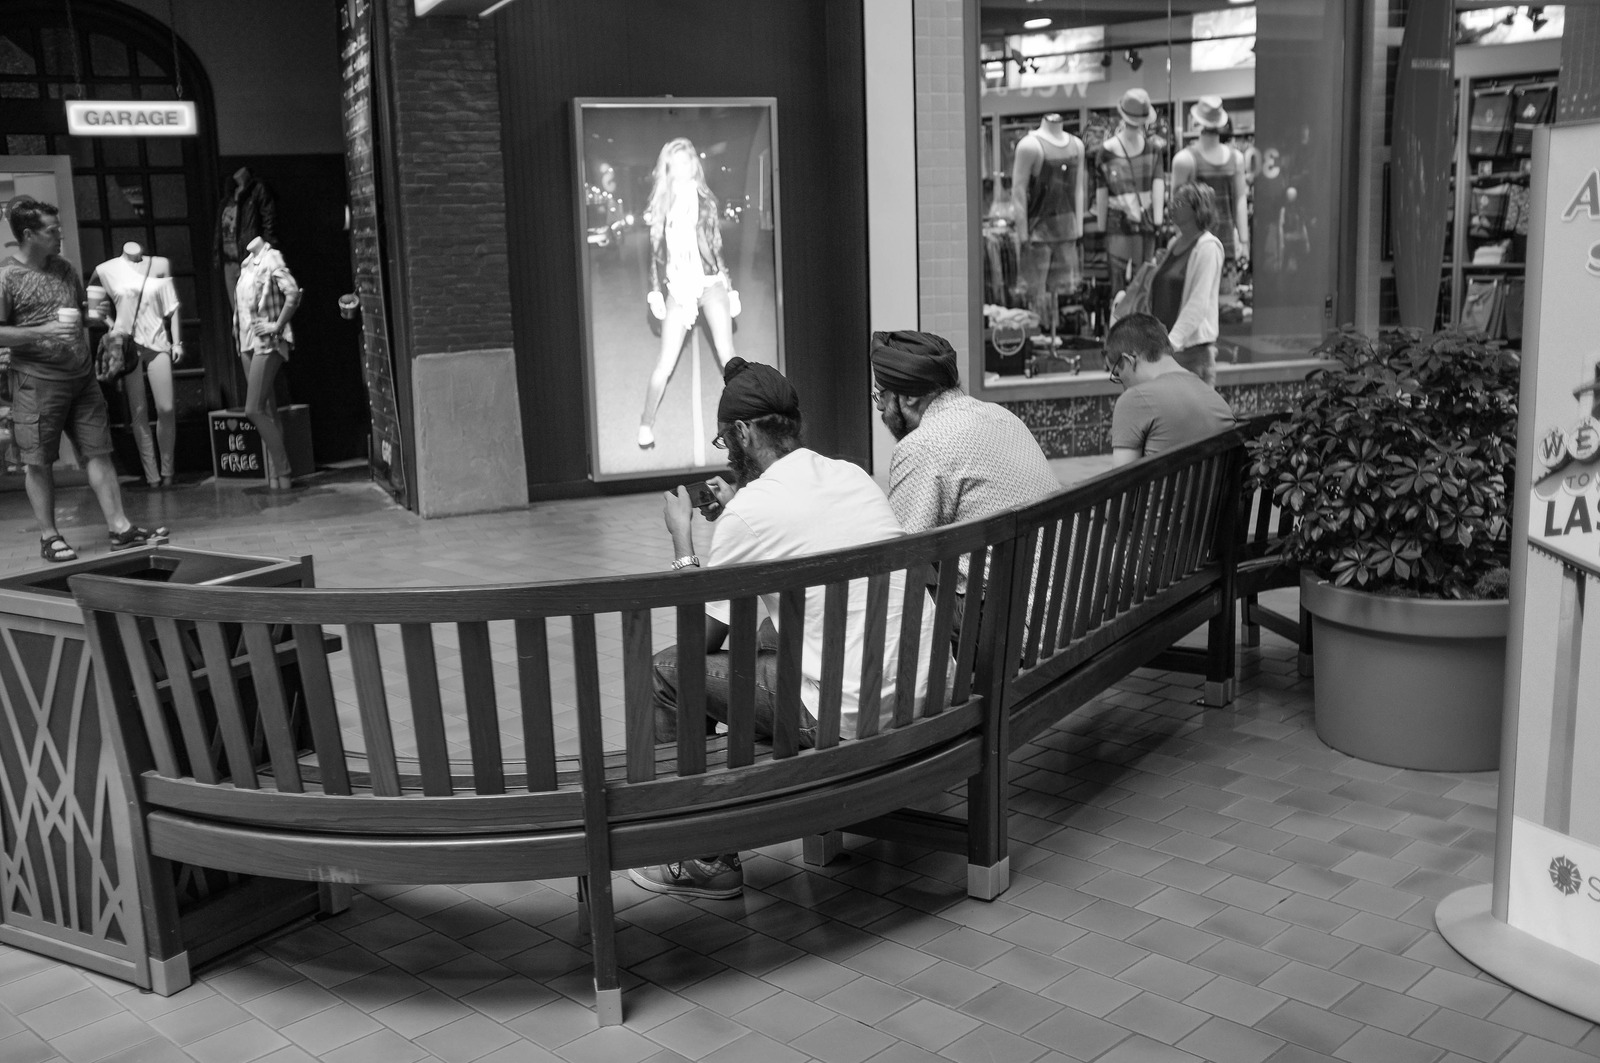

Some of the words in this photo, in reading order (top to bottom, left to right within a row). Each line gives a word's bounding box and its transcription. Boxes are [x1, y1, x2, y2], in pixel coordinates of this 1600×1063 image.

[83, 109, 179, 127] GARAGE
[220, 452, 259, 472] FREE
[1565, 472, 1591, 489] TO
[1544, 496, 1600, 537] LA
